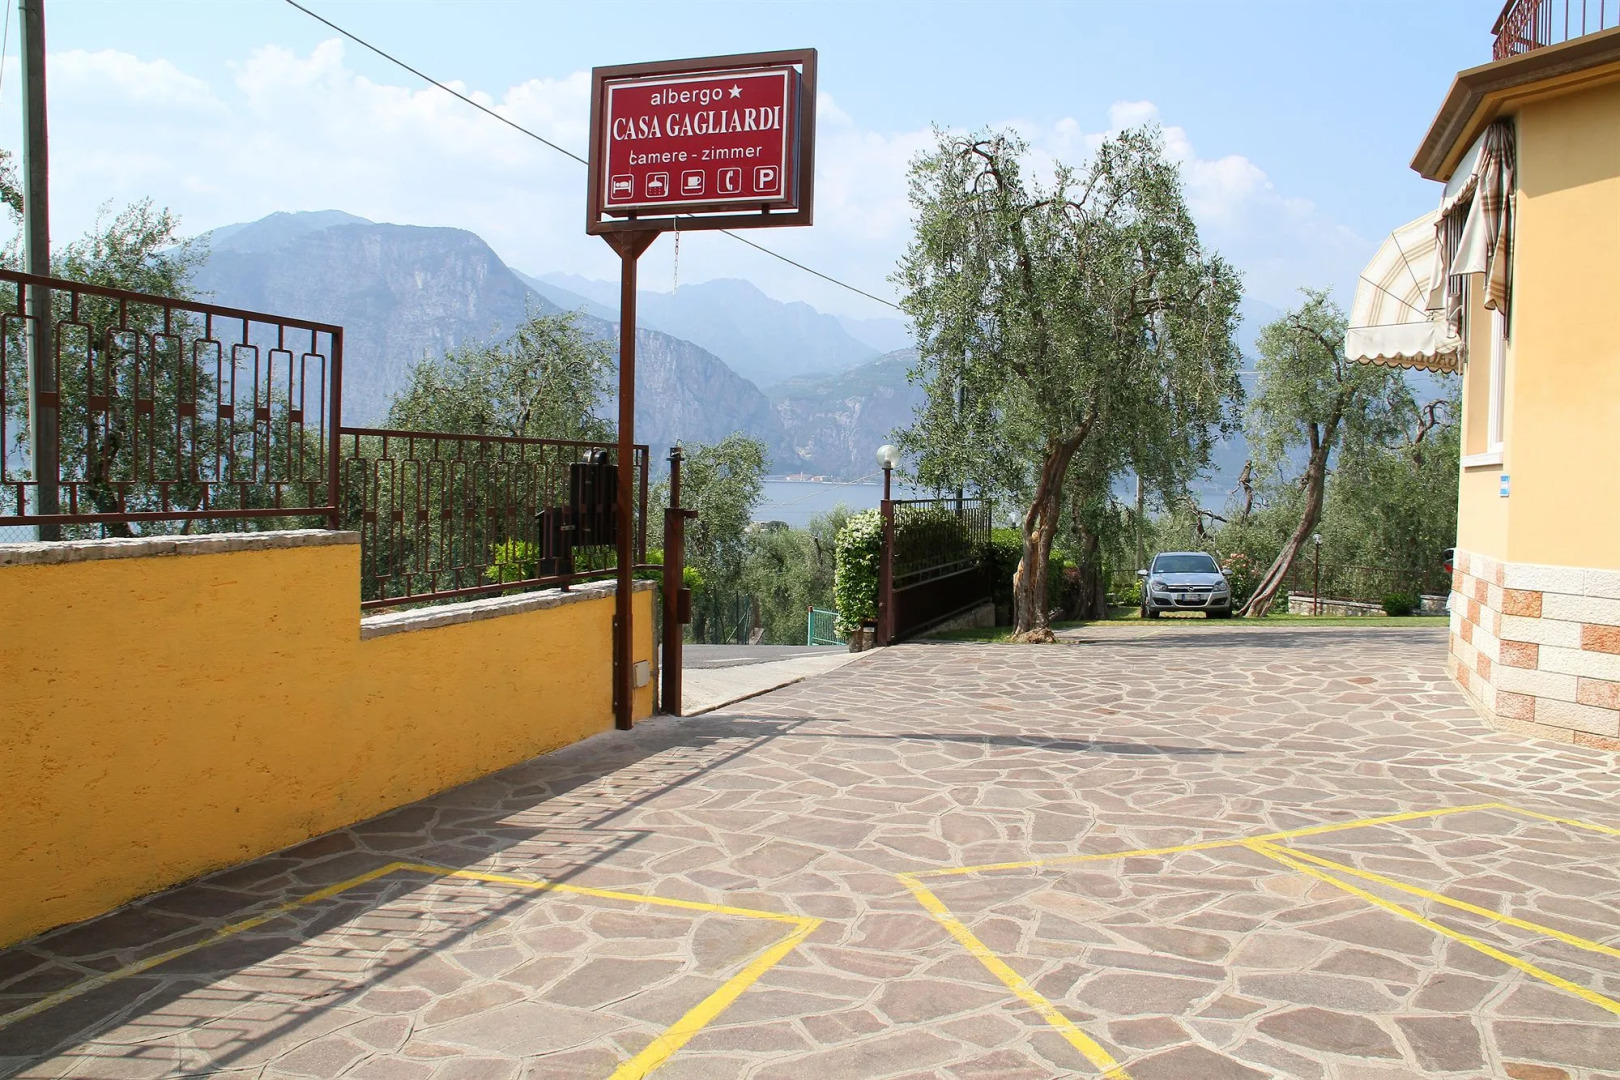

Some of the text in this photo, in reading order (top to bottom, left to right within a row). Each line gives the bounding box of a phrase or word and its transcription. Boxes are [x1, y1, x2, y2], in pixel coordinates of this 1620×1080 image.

[650, 87, 723, 106] albergo
[613, 106, 781, 141] CASA GAGLIARDI
[629, 150, 687, 165] camere
[701, 146, 763, 161] zimmer
[759, 169, 775, 189] P
